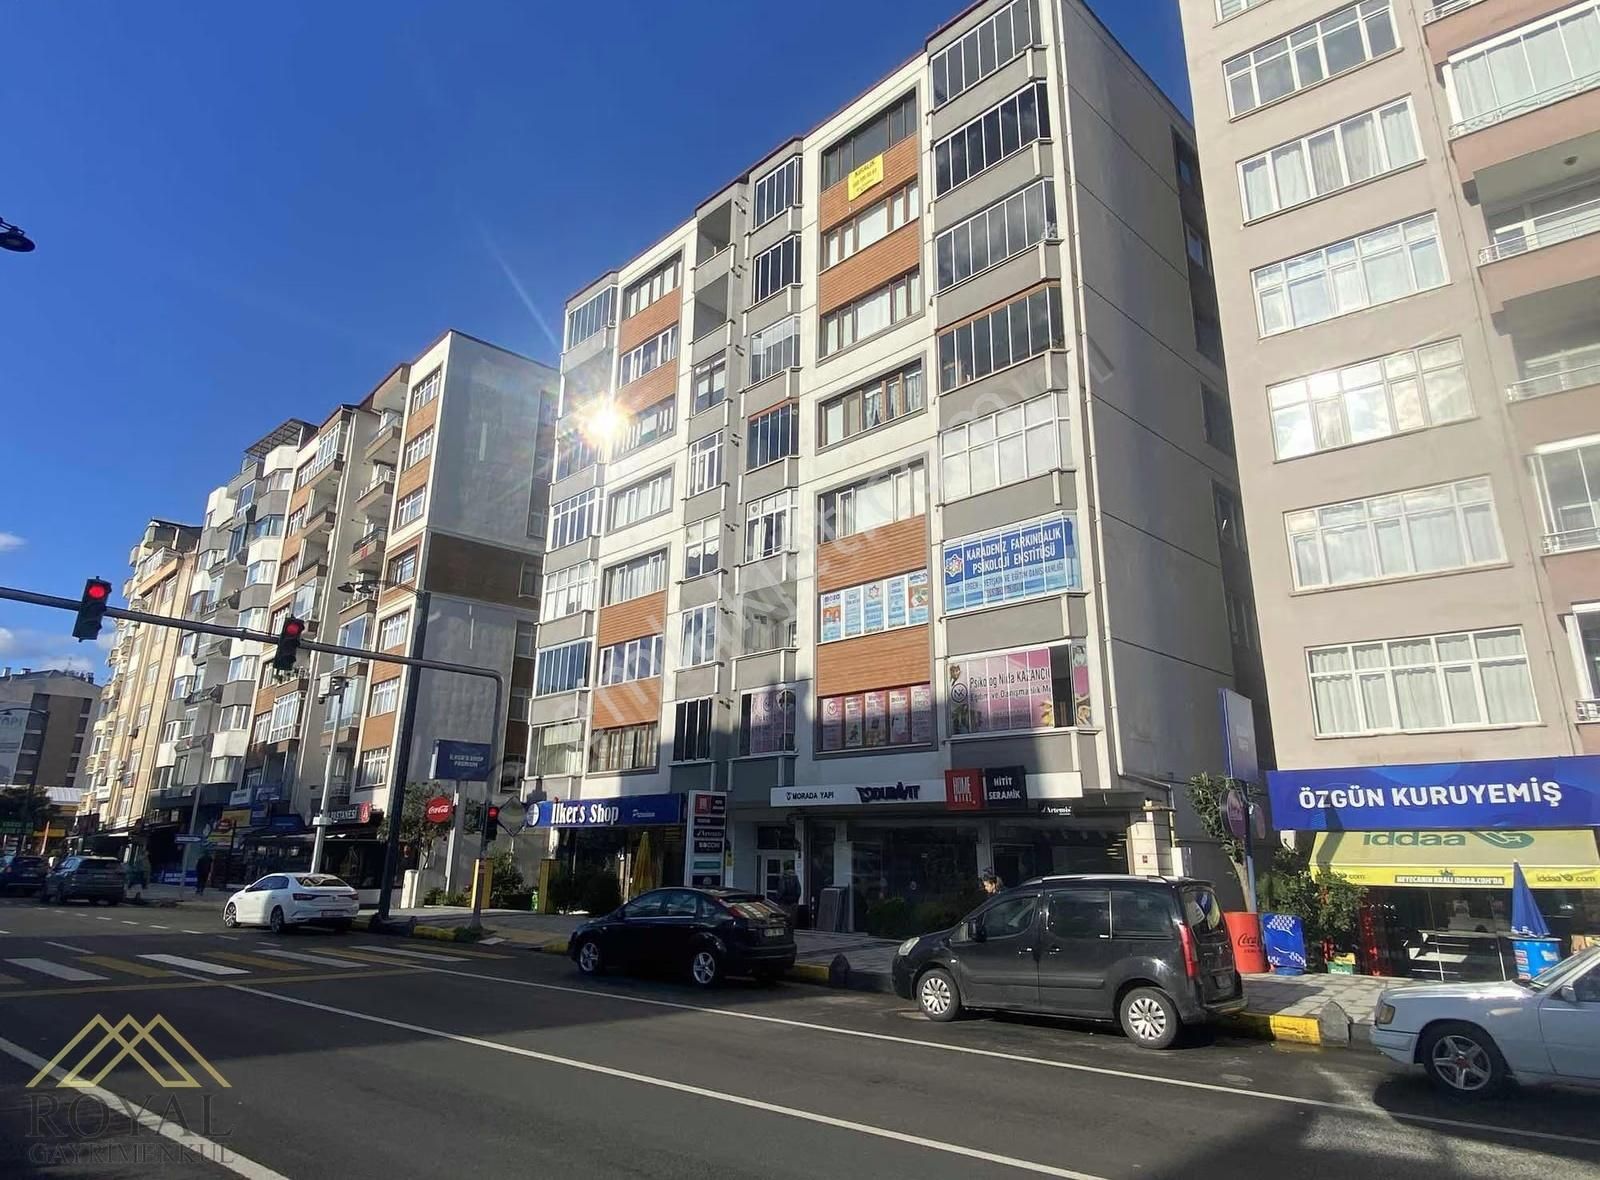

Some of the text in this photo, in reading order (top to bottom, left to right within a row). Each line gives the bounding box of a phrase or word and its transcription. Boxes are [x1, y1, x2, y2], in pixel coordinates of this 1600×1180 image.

[1011, 527, 1061, 550] FARKINDALIK
[1013, 540, 1056, 565] ENSTİTÜSÜ
[969, 676, 998, 689] Psikoog
[993, 776, 1013, 787] HİTİT
[792, 791, 835, 800] MORADA YAPI
[988, 789, 1021, 800] SERAMİK
[1299, 777, 1563, 809] ÖZGÜN KURUYEMİŞ
[588, 803, 620, 826] Shop
[1363, 831, 1466, 846] iddaa
